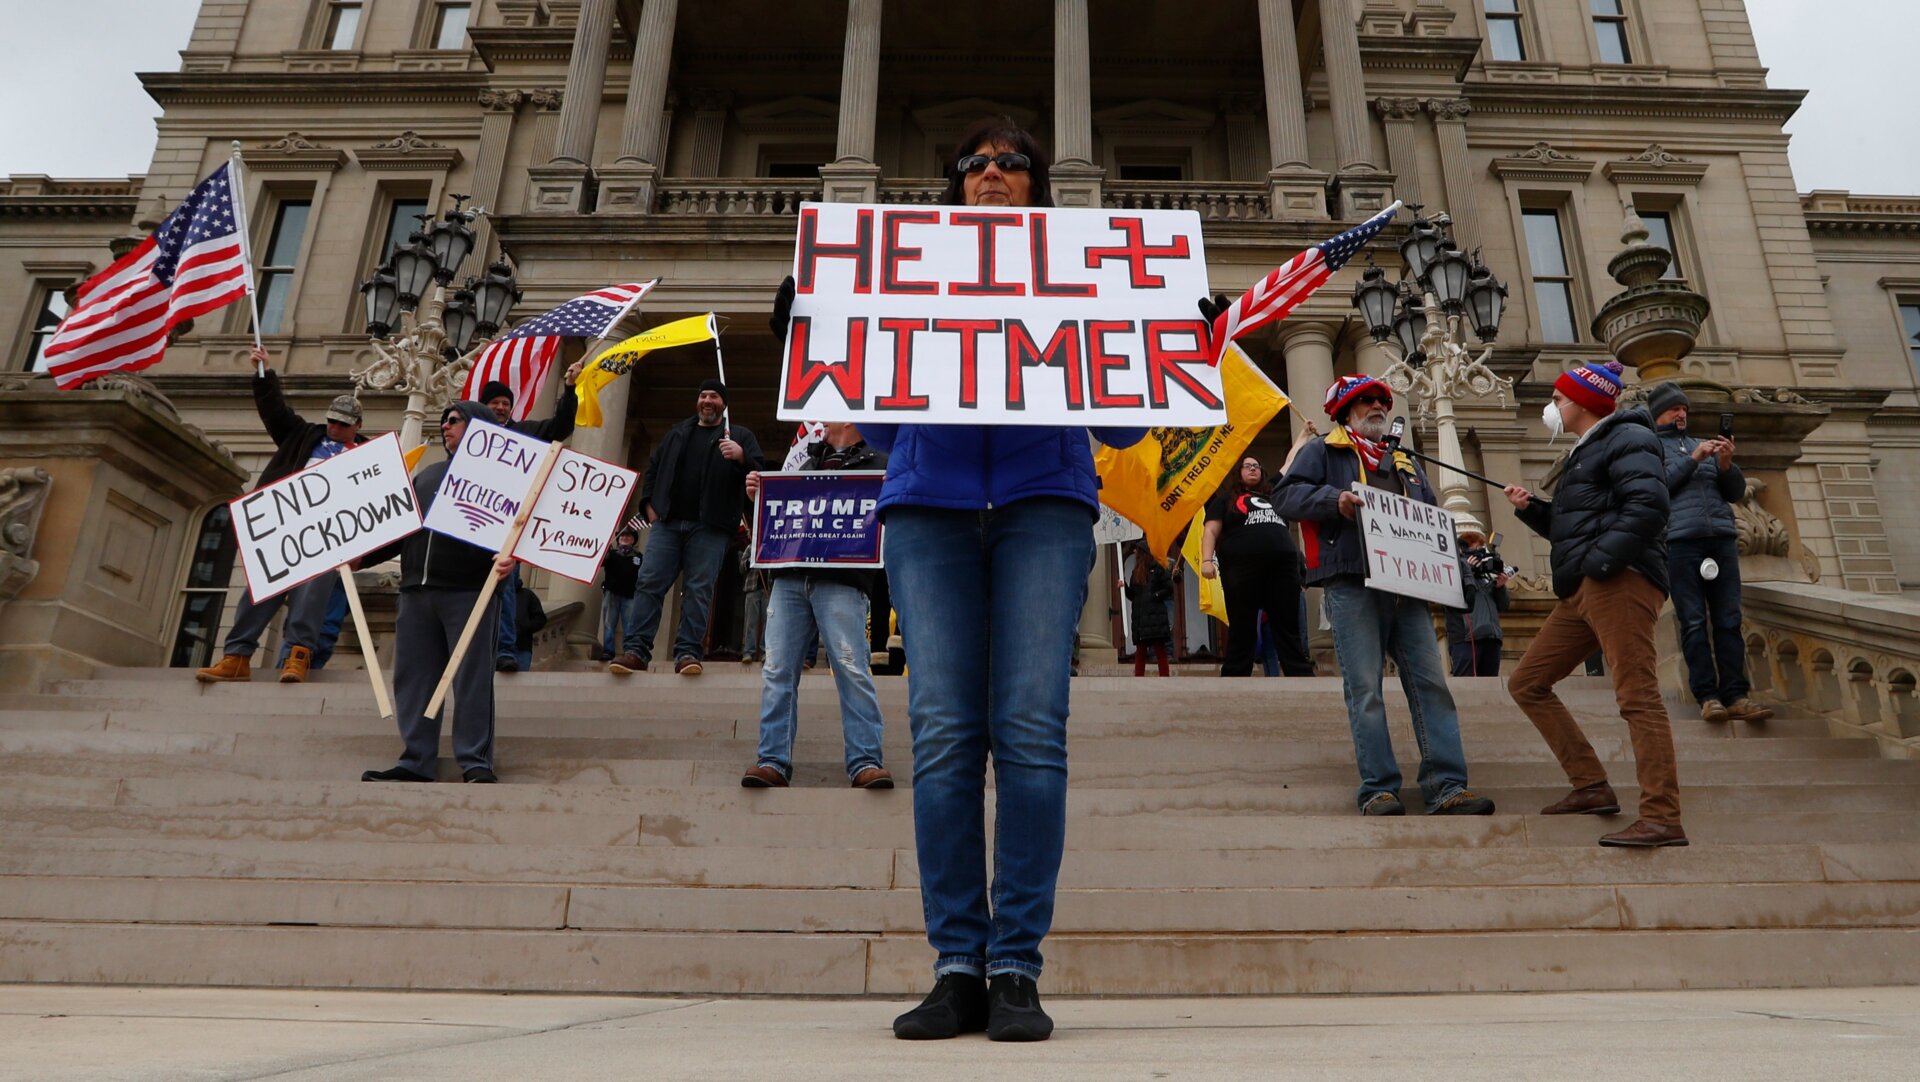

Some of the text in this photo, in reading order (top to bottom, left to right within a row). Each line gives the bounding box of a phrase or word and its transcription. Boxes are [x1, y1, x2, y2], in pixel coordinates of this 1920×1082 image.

[797, 208, 1097, 297] HEIL
[783, 316, 1224, 411] WITMER
[1587, 373, 1617, 396] BAND
[466, 429, 537, 474] OPEN
[1161, 423, 1235, 512] DONT TREAD ON ME
[443, 473, 521, 519] MICHIGAN
[560, 460, 627, 497] STOP
[241, 463, 382, 542] END THE
[561, 500, 593, 521] the
[766, 499, 877, 517] TRUMP
[255, 486, 415, 584] LOCKDOWN
[774, 518, 864, 530] PENCE
[1370, 517, 1382, 534] A
[1437, 533, 1448, 552] B
[1374, 549, 1455, 586] TYRANT
